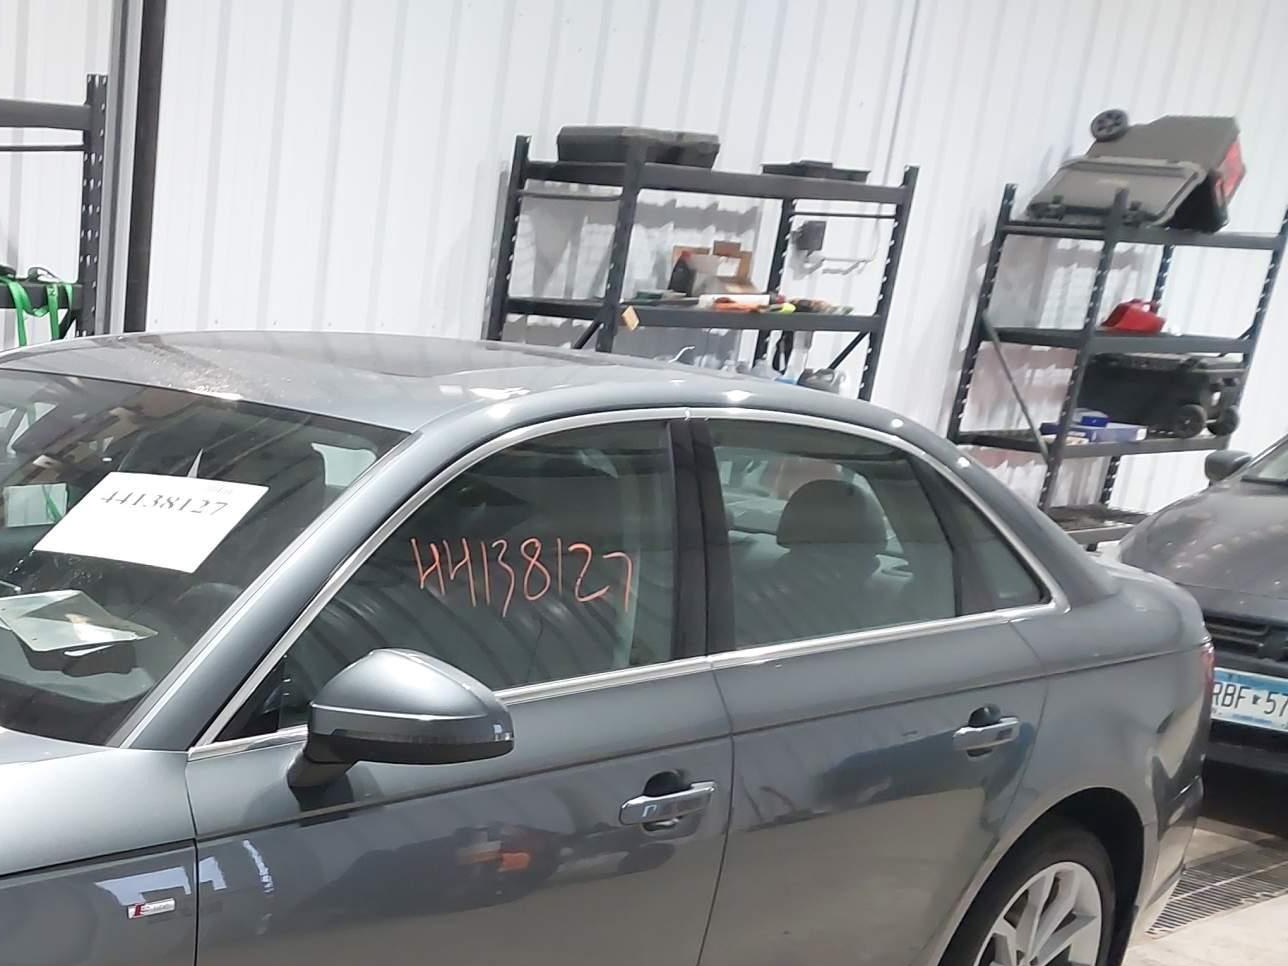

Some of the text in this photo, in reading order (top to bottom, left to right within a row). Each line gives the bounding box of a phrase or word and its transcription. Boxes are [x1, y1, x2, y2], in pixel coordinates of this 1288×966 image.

[99, 490, 230, 516] 44138127
[410, 537, 633, 618] 44138127
[1212, 681, 1252, 709] RBF
